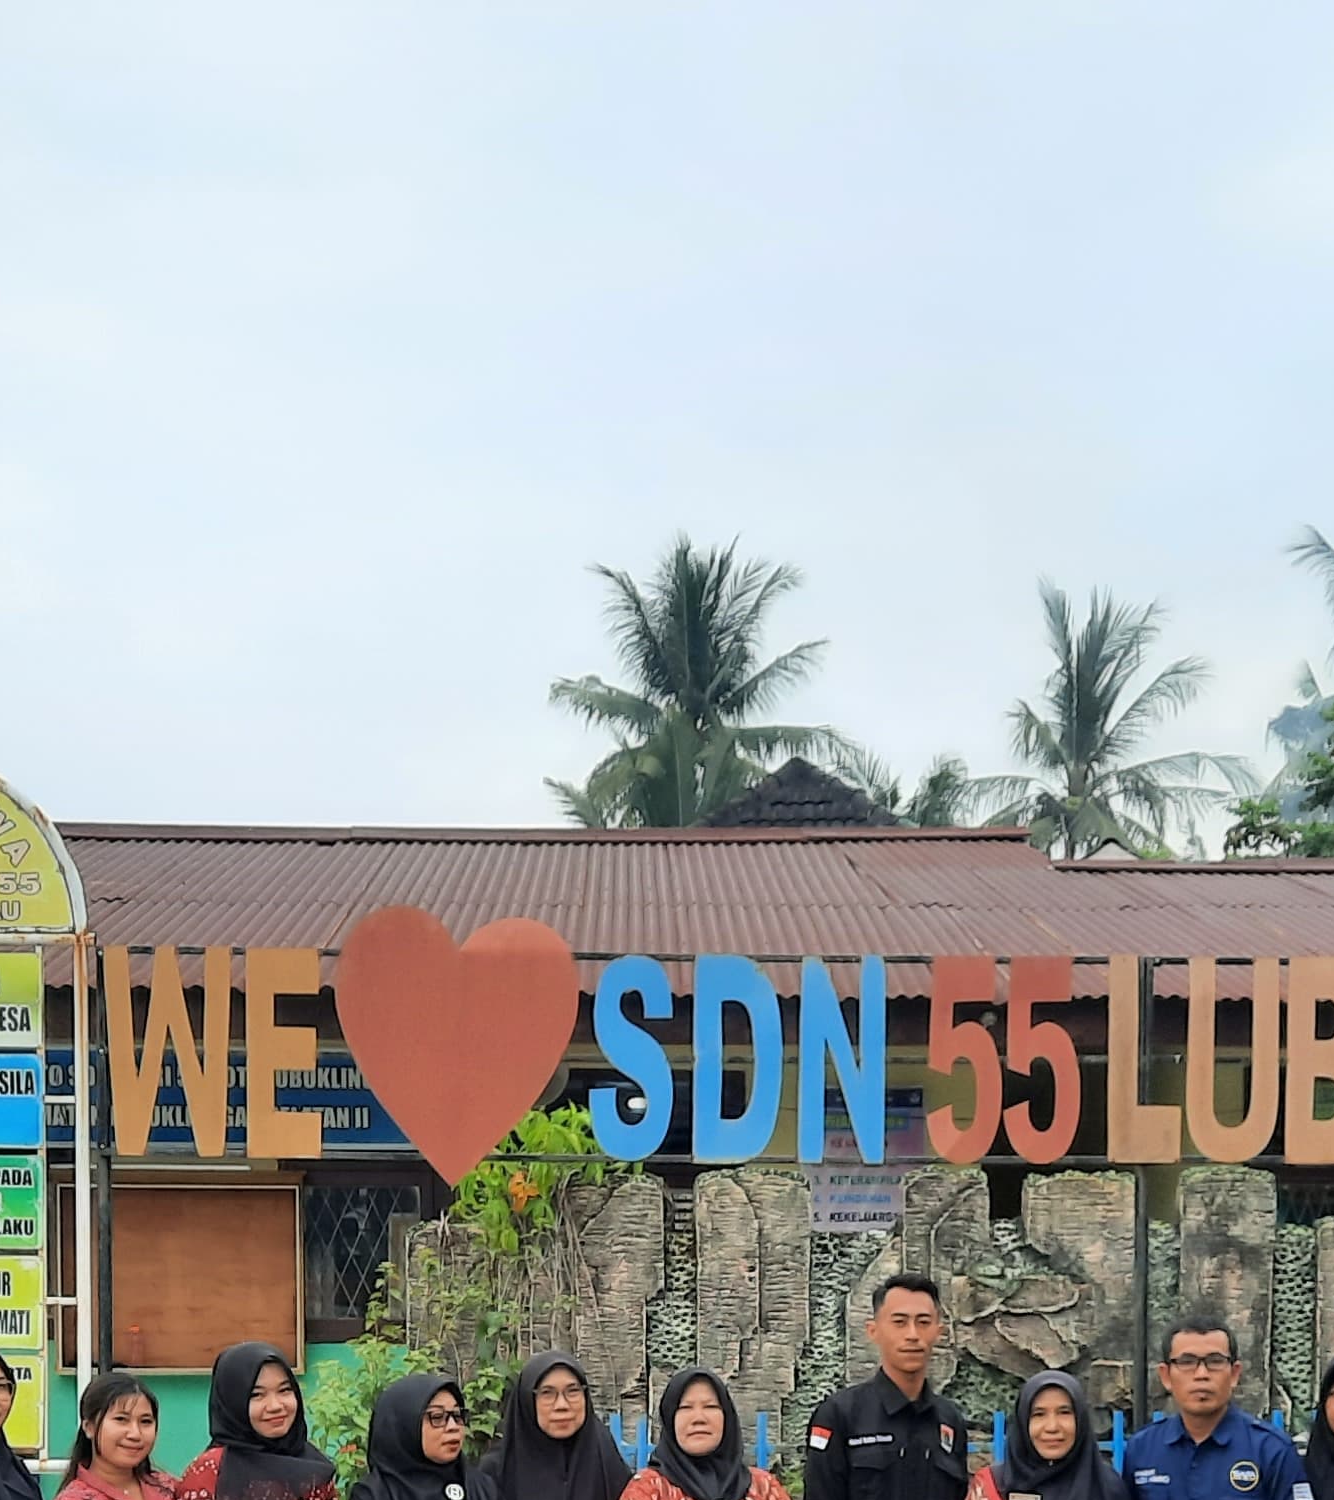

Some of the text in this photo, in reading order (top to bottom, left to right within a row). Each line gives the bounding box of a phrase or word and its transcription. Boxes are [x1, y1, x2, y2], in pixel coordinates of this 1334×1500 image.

[103, 945, 323, 1159] WE
[589, 953, 886, 1164] SDN
[925, 956, 1082, 1165] 55
